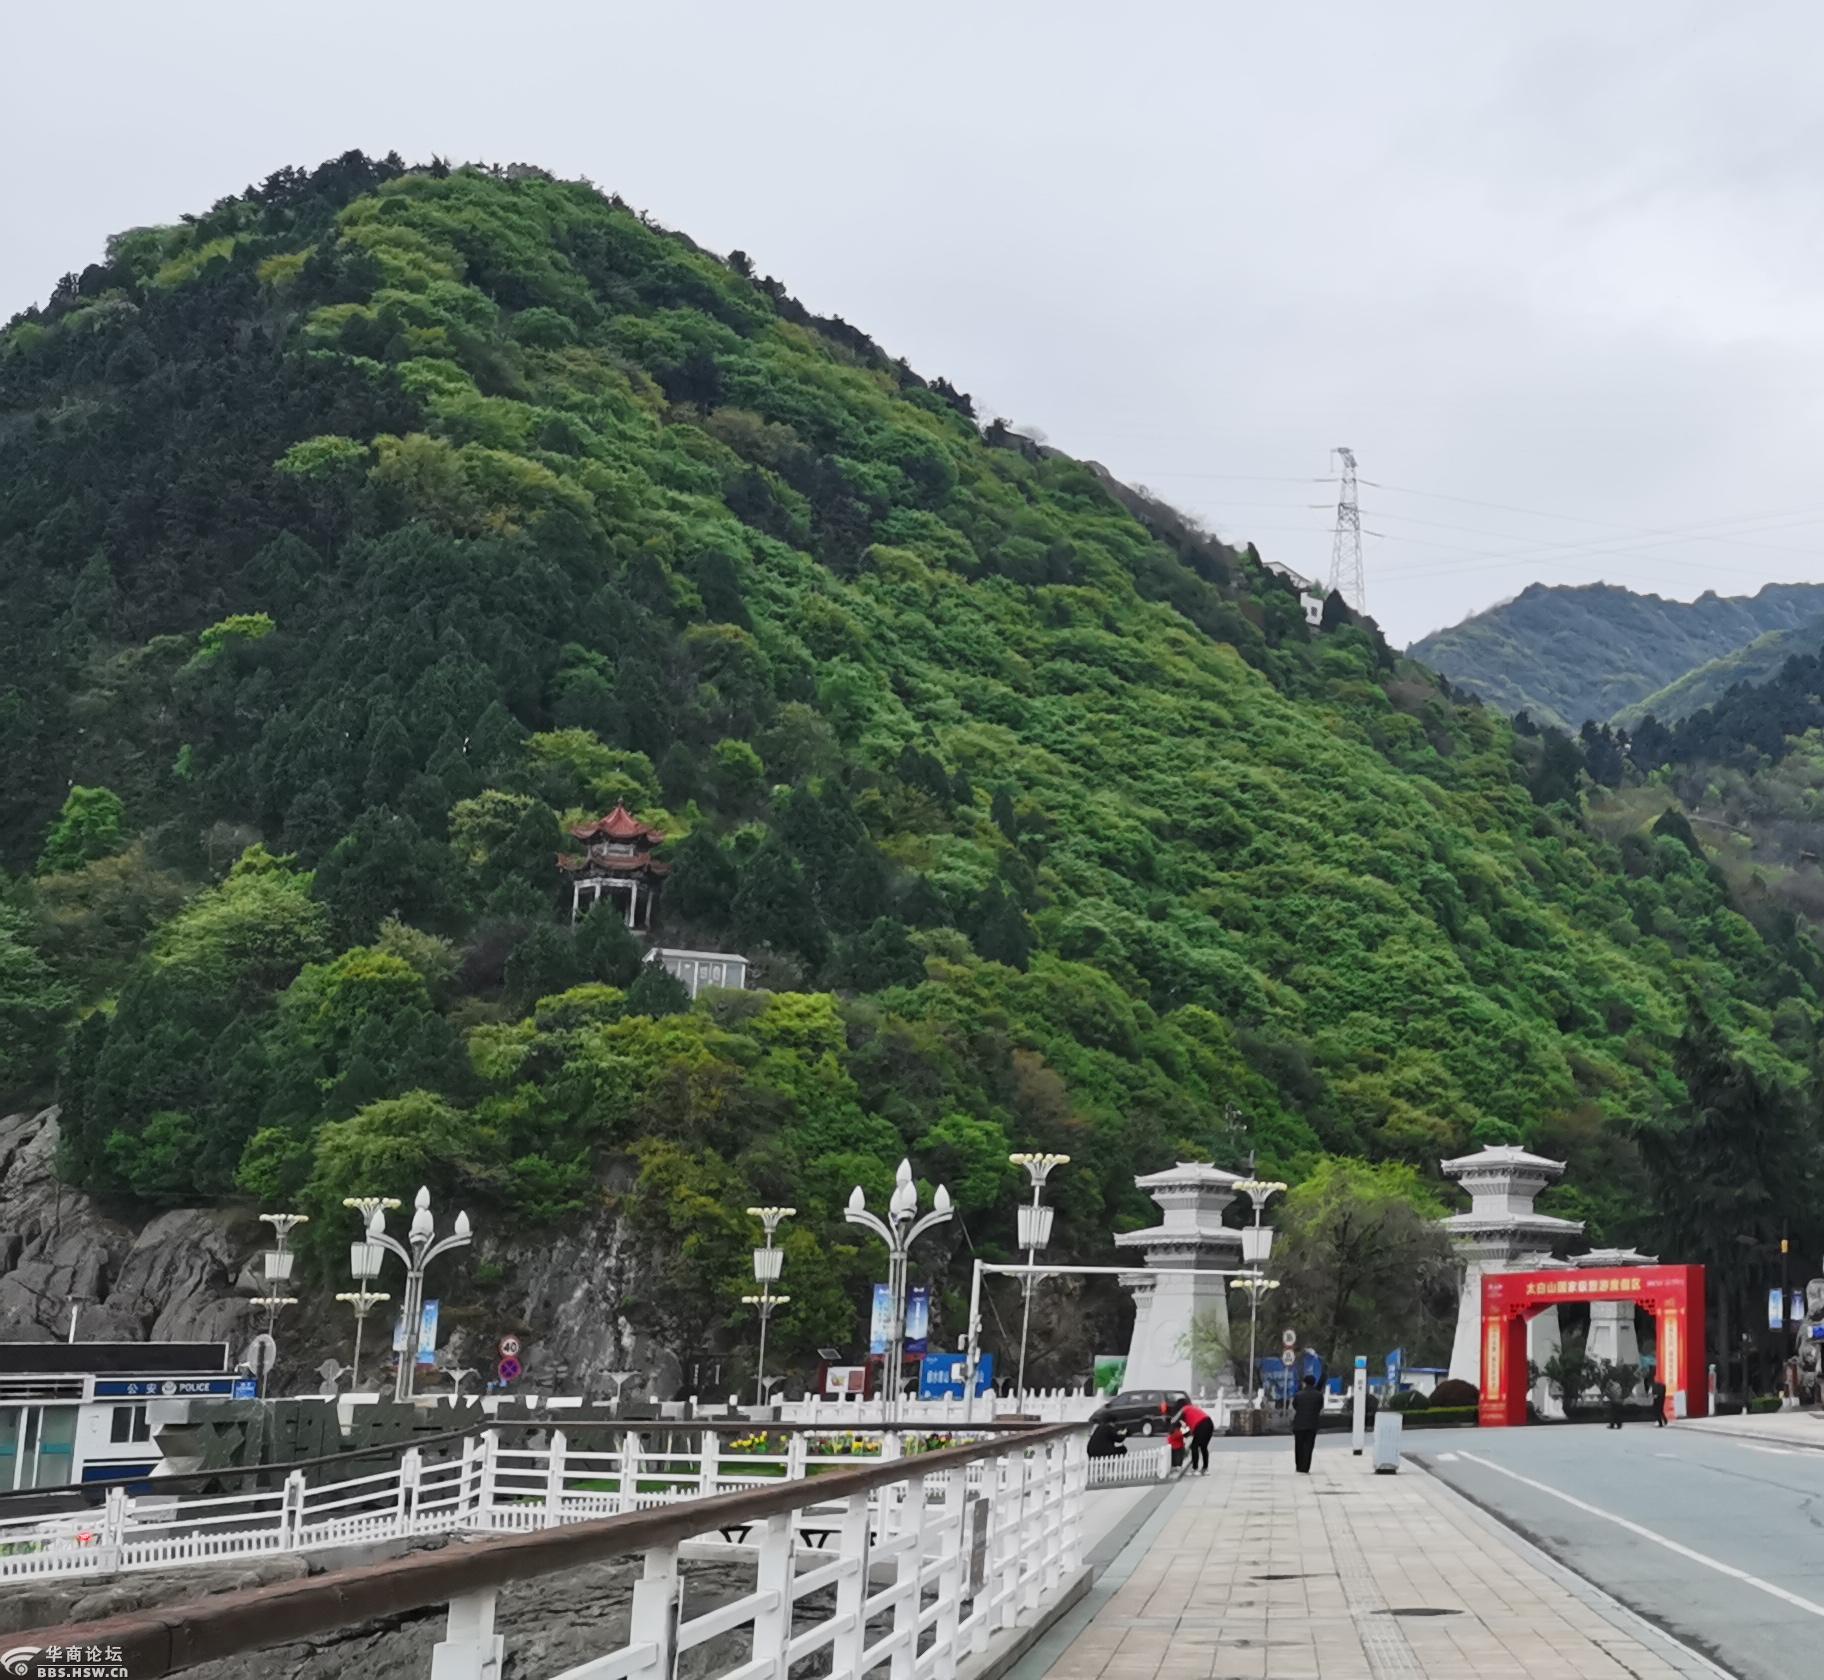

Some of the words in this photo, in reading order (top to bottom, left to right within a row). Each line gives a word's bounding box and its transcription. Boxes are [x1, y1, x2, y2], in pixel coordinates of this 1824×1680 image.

[503, 1342, 517, 1352] 40
[127, 1383, 157, 1394] 公安
[179, 1382, 210, 1392] POLICE
